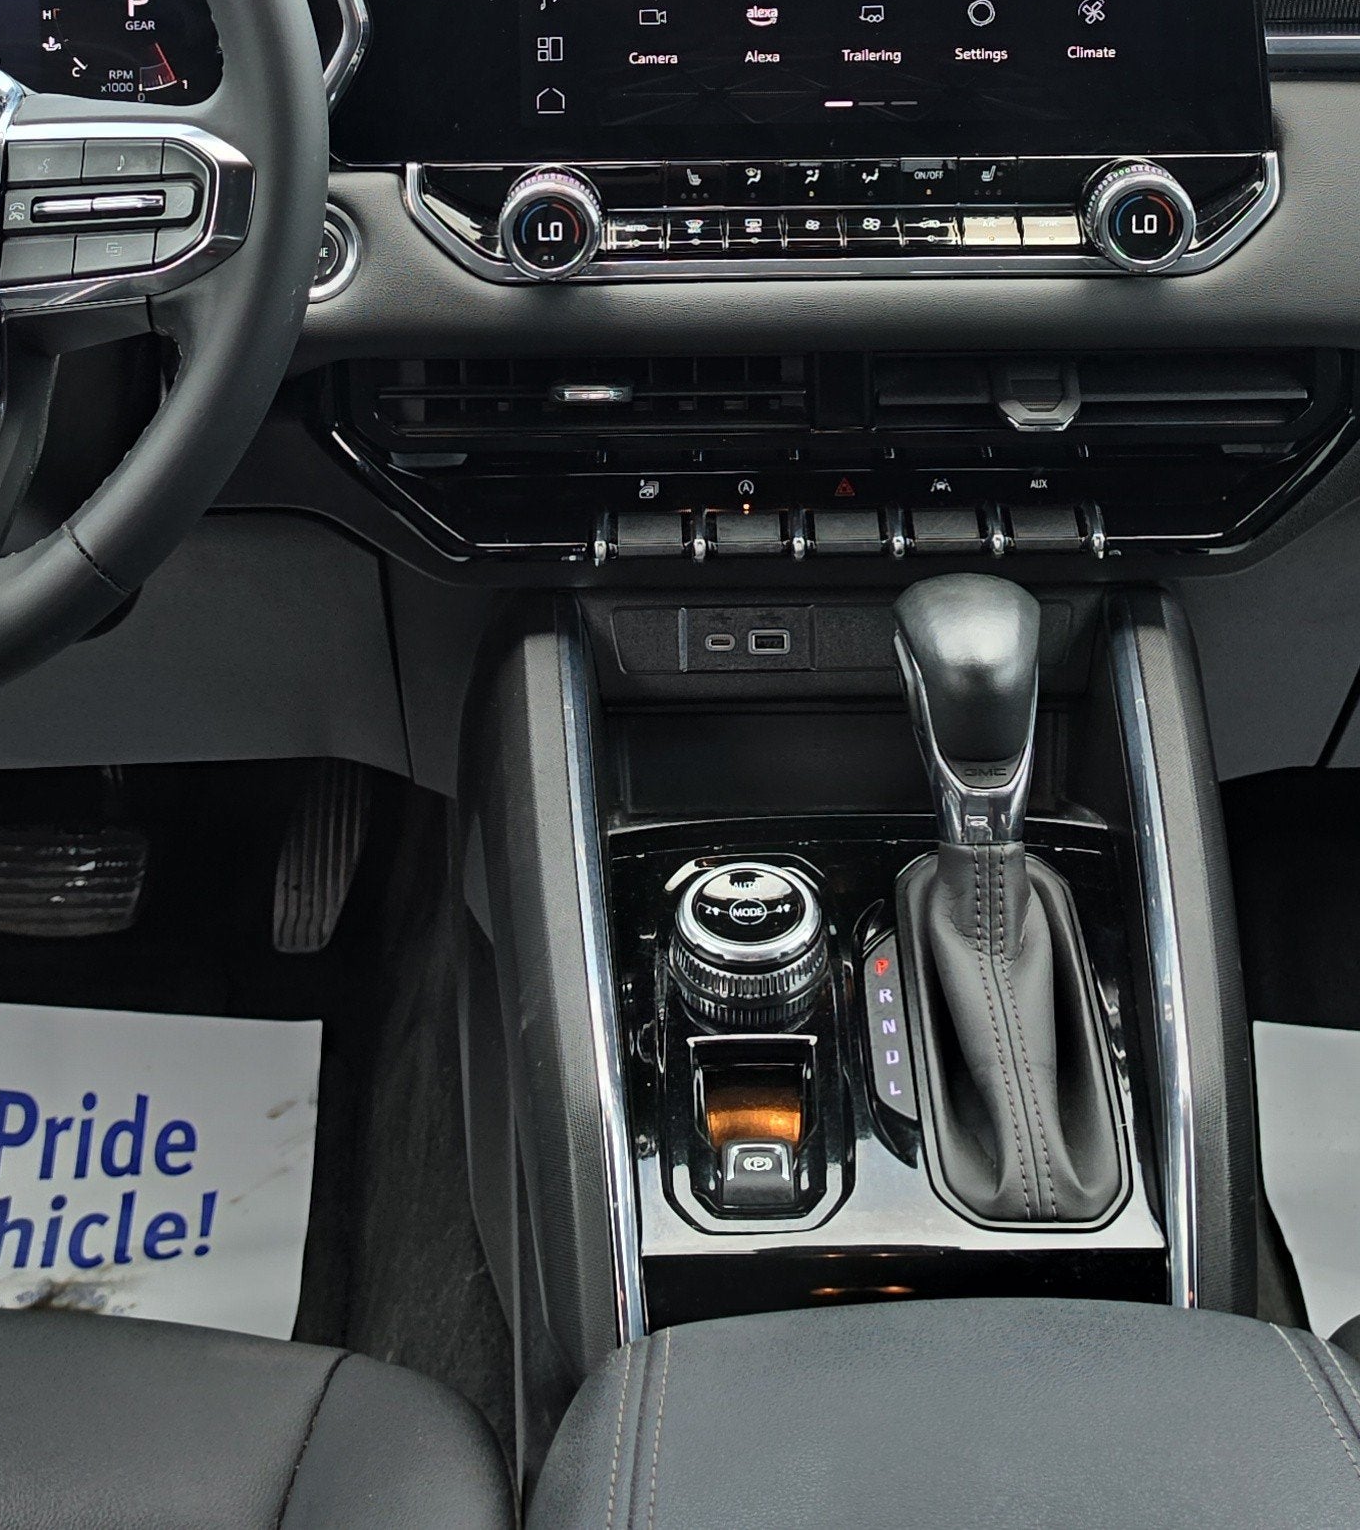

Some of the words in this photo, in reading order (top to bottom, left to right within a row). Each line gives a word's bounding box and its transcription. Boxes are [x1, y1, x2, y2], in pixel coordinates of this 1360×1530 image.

[42, 9, 52, 20] H
[745, 6, 778, 19] alexa
[125, 20, 156, 31] GEAR
[628, 51, 678, 65] Camera
[744, 50, 780, 64] Alexa
[841, 48, 902, 64] Trailering
[954, 46, 1008, 62] Settings
[1067, 45, 1116, 59] Climate
[71, 67, 81, 78] C
[108, 70, 134, 80] RPM
[100, 82, 134, 93] x1000
[914, 171, 944, 181] ON/OFF
[1131, 214, 1158, 234] LO
[537, 221, 563, 242] LO
[1030, 479, 1048, 490] AUX
[732, 906, 764, 918] MODE
[874, 958, 890, 976] P
[878, 988, 893, 1003] R
[882, 1019, 897, 1034] N
[885, 1049, 900, 1065] D
[889, 1080, 902, 1096] L
